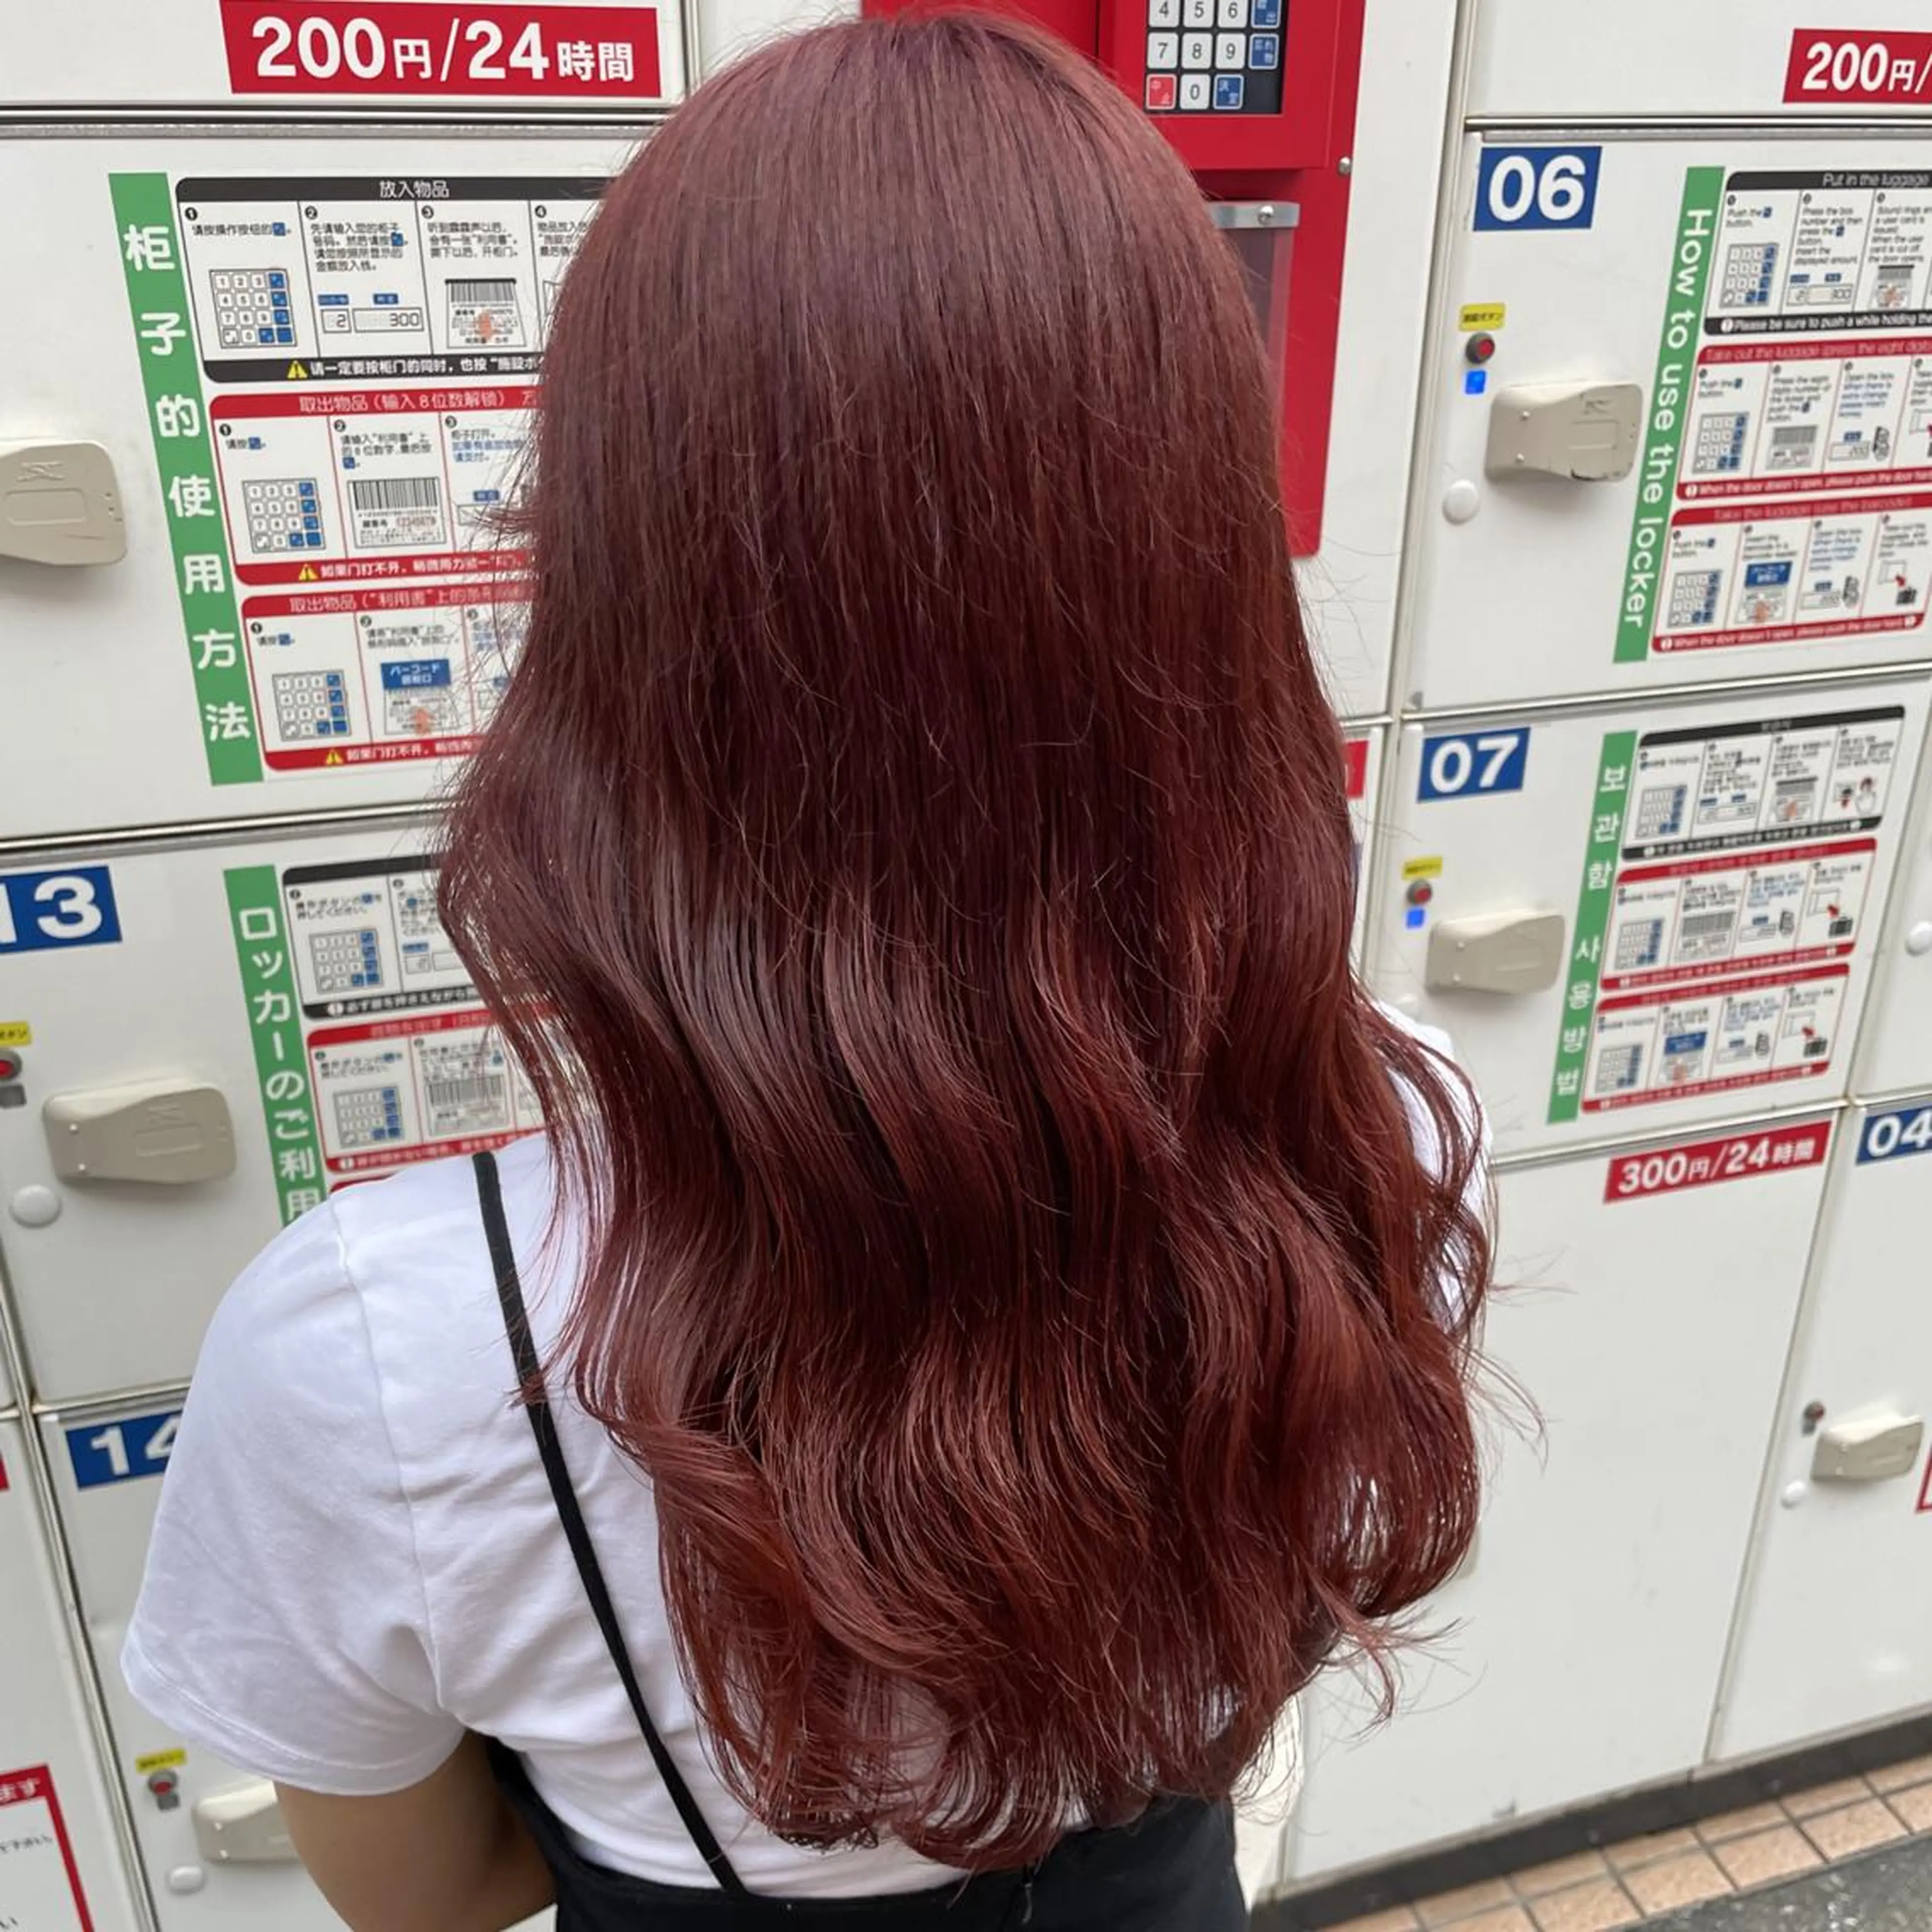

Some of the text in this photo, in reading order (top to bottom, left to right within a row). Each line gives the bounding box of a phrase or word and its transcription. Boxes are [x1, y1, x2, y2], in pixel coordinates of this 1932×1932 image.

[1159, 2, 1169, 18] 4
[1194, 2, 1204, 19] 5
[1228, 2, 1238, 19] 6
[253, 16, 633, 83] 200円/24時間
[1157, 42, 1168, 59] 7
[1192, 43, 1202, 59] 8
[1226, 43, 1236, 59] 9
[1189, 85, 1200, 100] 0
[380, 180, 450, 198] 放入物品
[1488, 155, 1586, 222] 06
[389, 312, 420, 328] 300
[1625, 208, 1713, 629] How to use the locker
[123, 223, 251, 742] 柜子的使用方法
[1430, 734, 1519, 793] 07
[1588, 763, 1627, 891] 보관함
[1618, 1136, 1816, 1193] 300円/24時間
